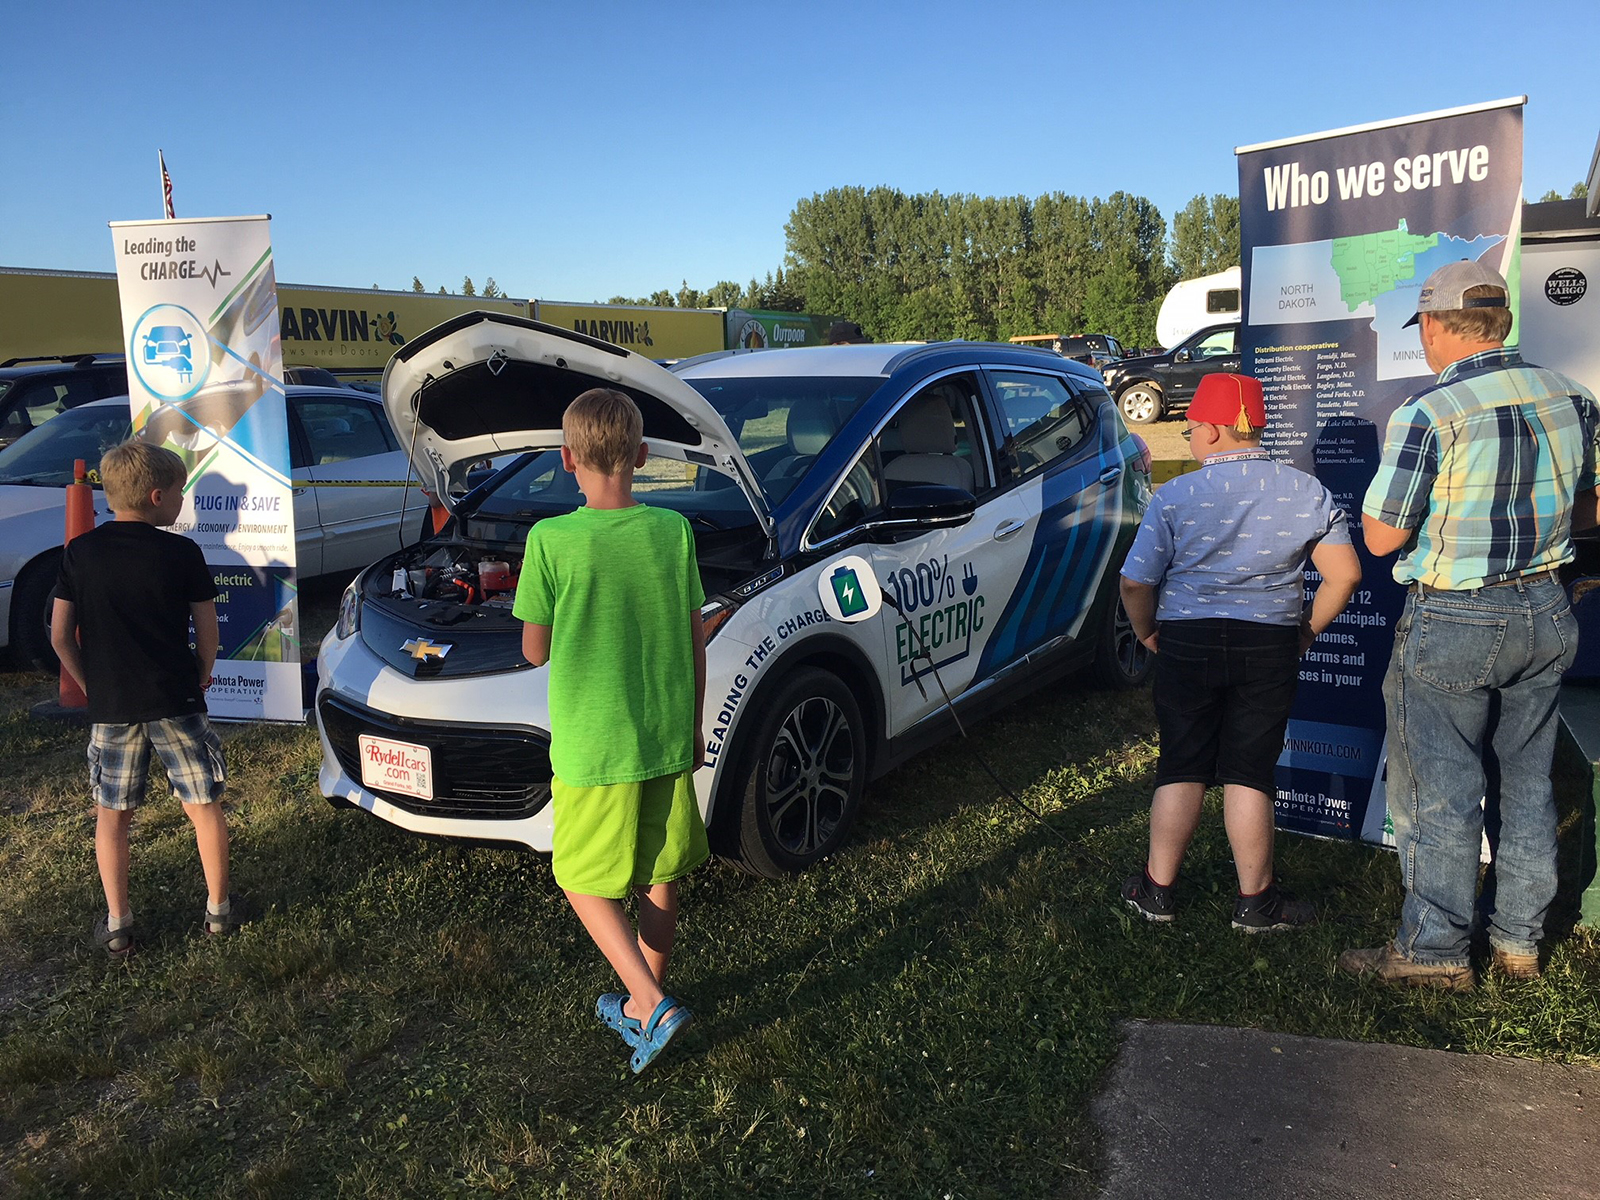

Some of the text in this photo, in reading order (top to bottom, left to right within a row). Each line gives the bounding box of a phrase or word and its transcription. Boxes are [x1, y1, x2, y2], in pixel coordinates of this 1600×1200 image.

[1263, 145, 1489, 212] Who we serve
[124, 236, 196, 257] Leading the
[141, 260, 196, 280] CHARGE
[1548, 278, 1586, 287] WELLS
[1280, 283, 1314, 297] NORTH
[1548, 286, 1584, 295] CARGO
[1278, 297, 1317, 311] DAKOTA
[281, 307, 370, 342] ARVIN
[574, 319, 634, 344] MARVIN
[282, 344, 379, 356] ows and Doors
[1255, 342, 1339, 354] Distribution cooperatives
[1393, 349, 1425, 361] MINNE
[1317, 363, 1333, 371] Fargo,
[1287, 373, 1306, 381] Electric
[1316, 372, 1341, 380] Langdon,
[1316, 381, 1335, 390] Bagley,
[1334, 390, 1350, 398] Forks,
[1352, 389, 1365, 397] N.D.
[1275, 421, 1294, 429] Electric
[1292, 430, 1308, 438] Co-op
[1274, 438, 1304, 446] Association
[194, 495, 280, 512] PLUG IN & SAVE
[166, 522, 190, 533] ENERGY
[197, 522, 230, 533] ECONOMY
[238, 523, 288, 534] ENVIRONMENT
[213, 572, 253, 586] electric
[887, 554, 955, 615] 100%
[1359, 590, 1372, 605] 12
[776, 607, 832, 640] CHARGE
[895, 595, 985, 666] ELECTRIC
[745, 635, 776, 672] THE
[1305, 648, 1365, 667] farms and
[212, 674, 265, 688] nkota Power
[1321, 669, 1333, 684] in
[1335, 673, 1363, 688] your
[206, 687, 264, 696] OOPERATIVE
[704, 674, 748, 769] LEADING
[365, 744, 427, 773] Rydellcars
[384, 767, 410, 782] .com
[1276, 786, 1353, 811] innkota Power
[1274, 800, 1351, 820] OOPERATIVE
